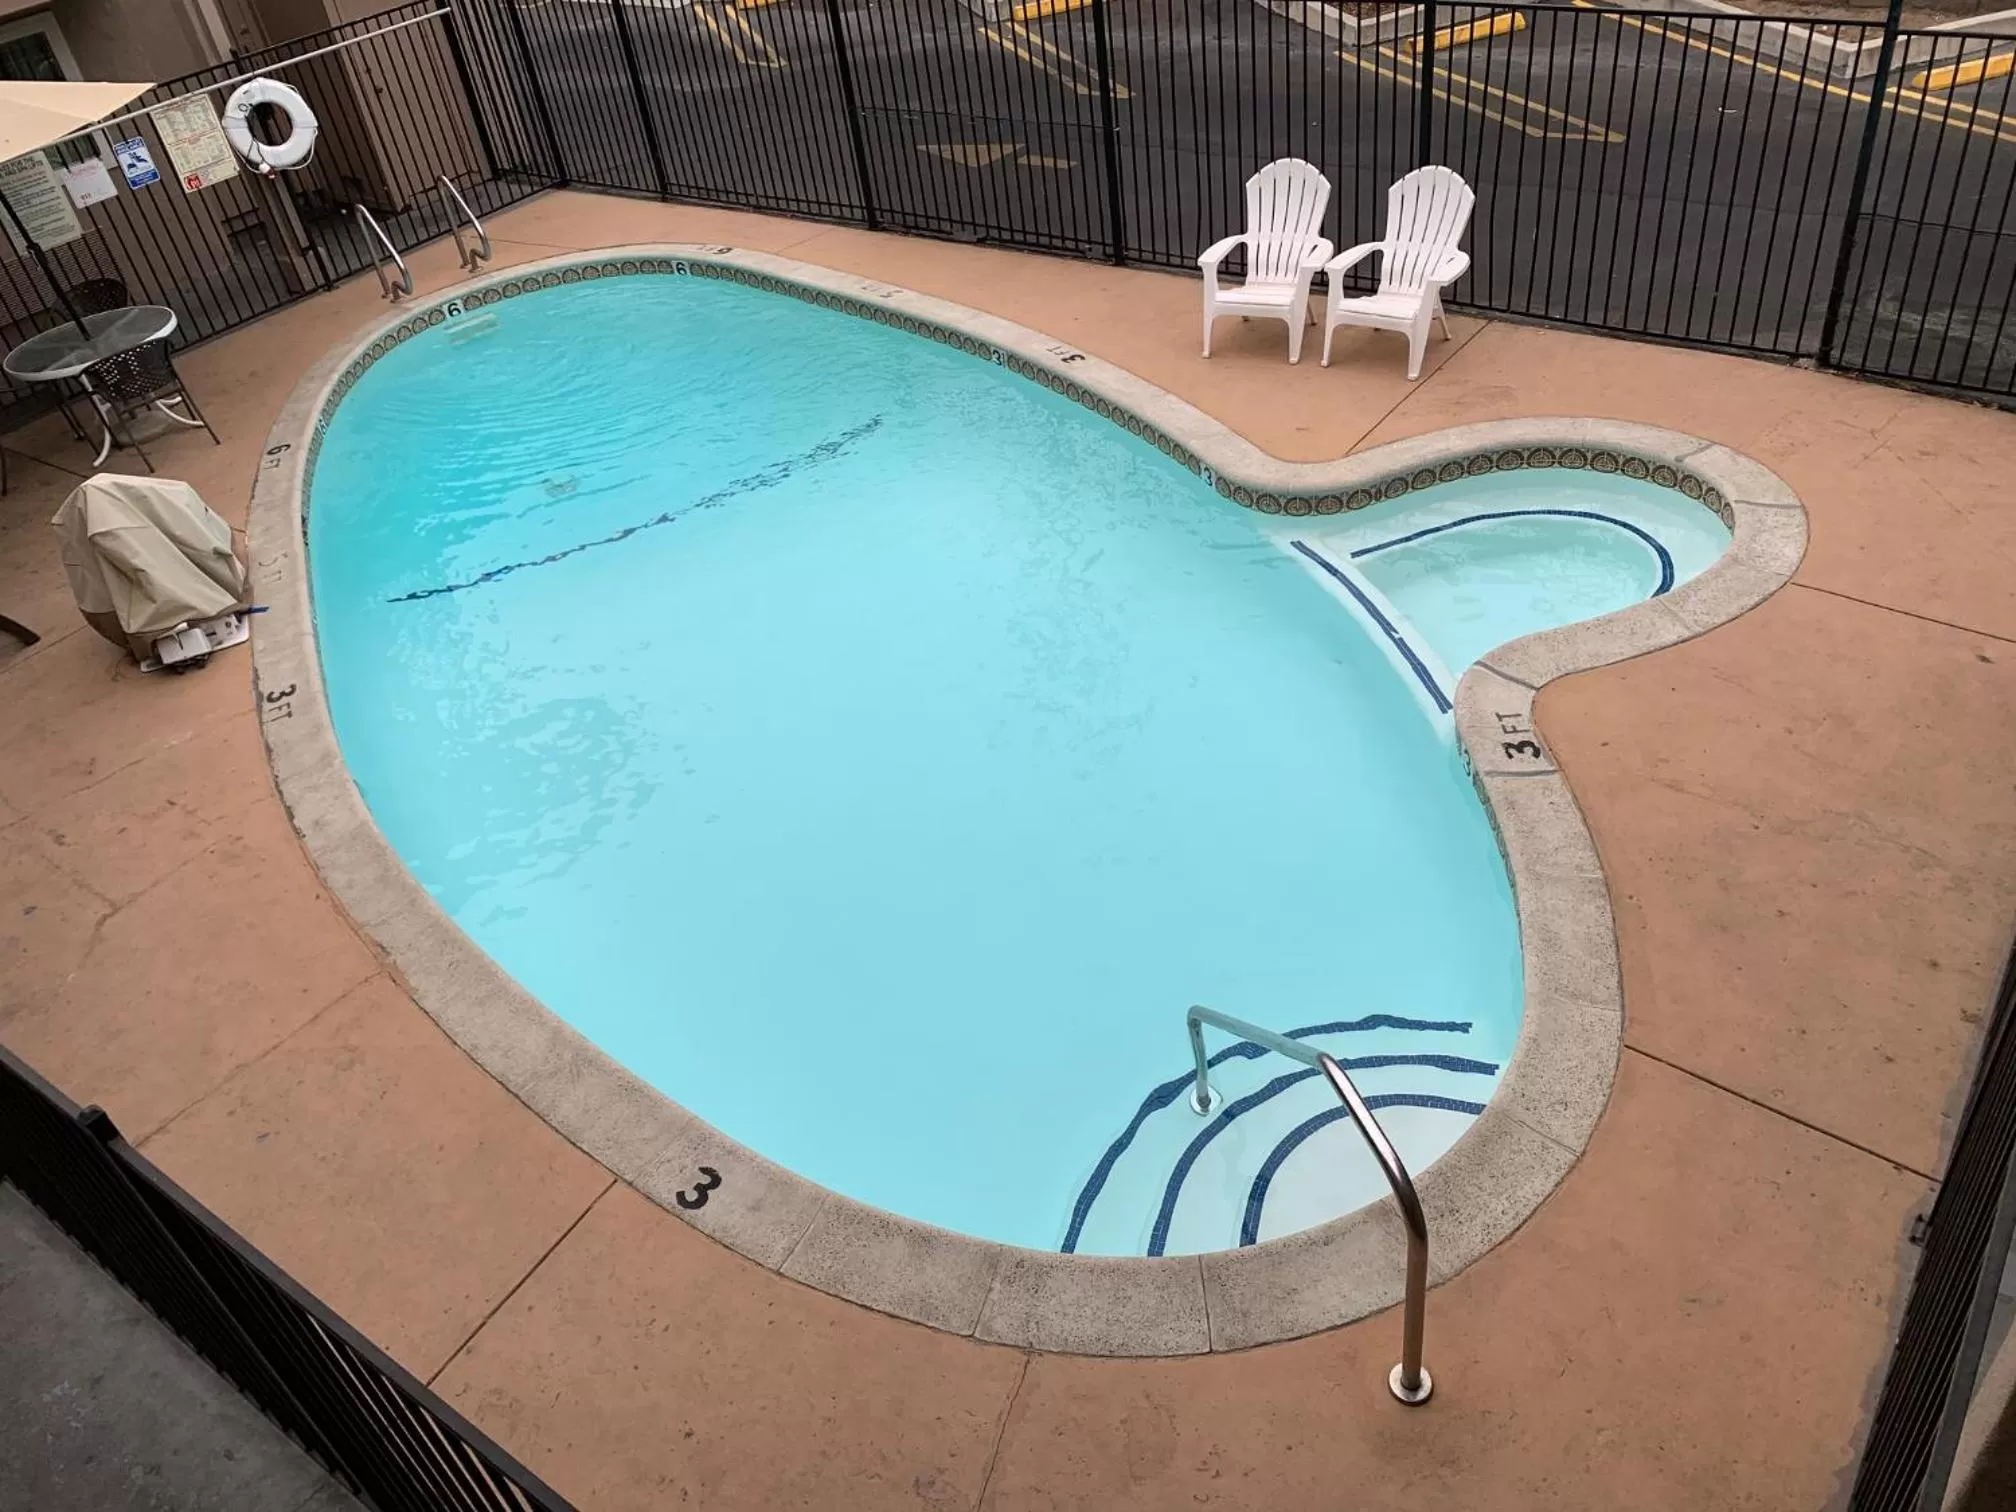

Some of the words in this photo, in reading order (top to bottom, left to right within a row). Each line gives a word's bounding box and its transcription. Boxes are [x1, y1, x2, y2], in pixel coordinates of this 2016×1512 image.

[676, 261, 688, 276] 6
[447, 302, 461, 317] 6
[1060, 354, 1086, 363] 3
[266, 443, 291, 456] 6
[1203, 466, 1213, 486] 3
[266, 683, 297, 703] 3
[268, 702, 293, 722] FT
[1495, 712, 1530, 734] FT
[1502, 740, 1541, 759] 3
[1463, 748, 1471, 777] 3
[676, 1166, 722, 1210] 3
